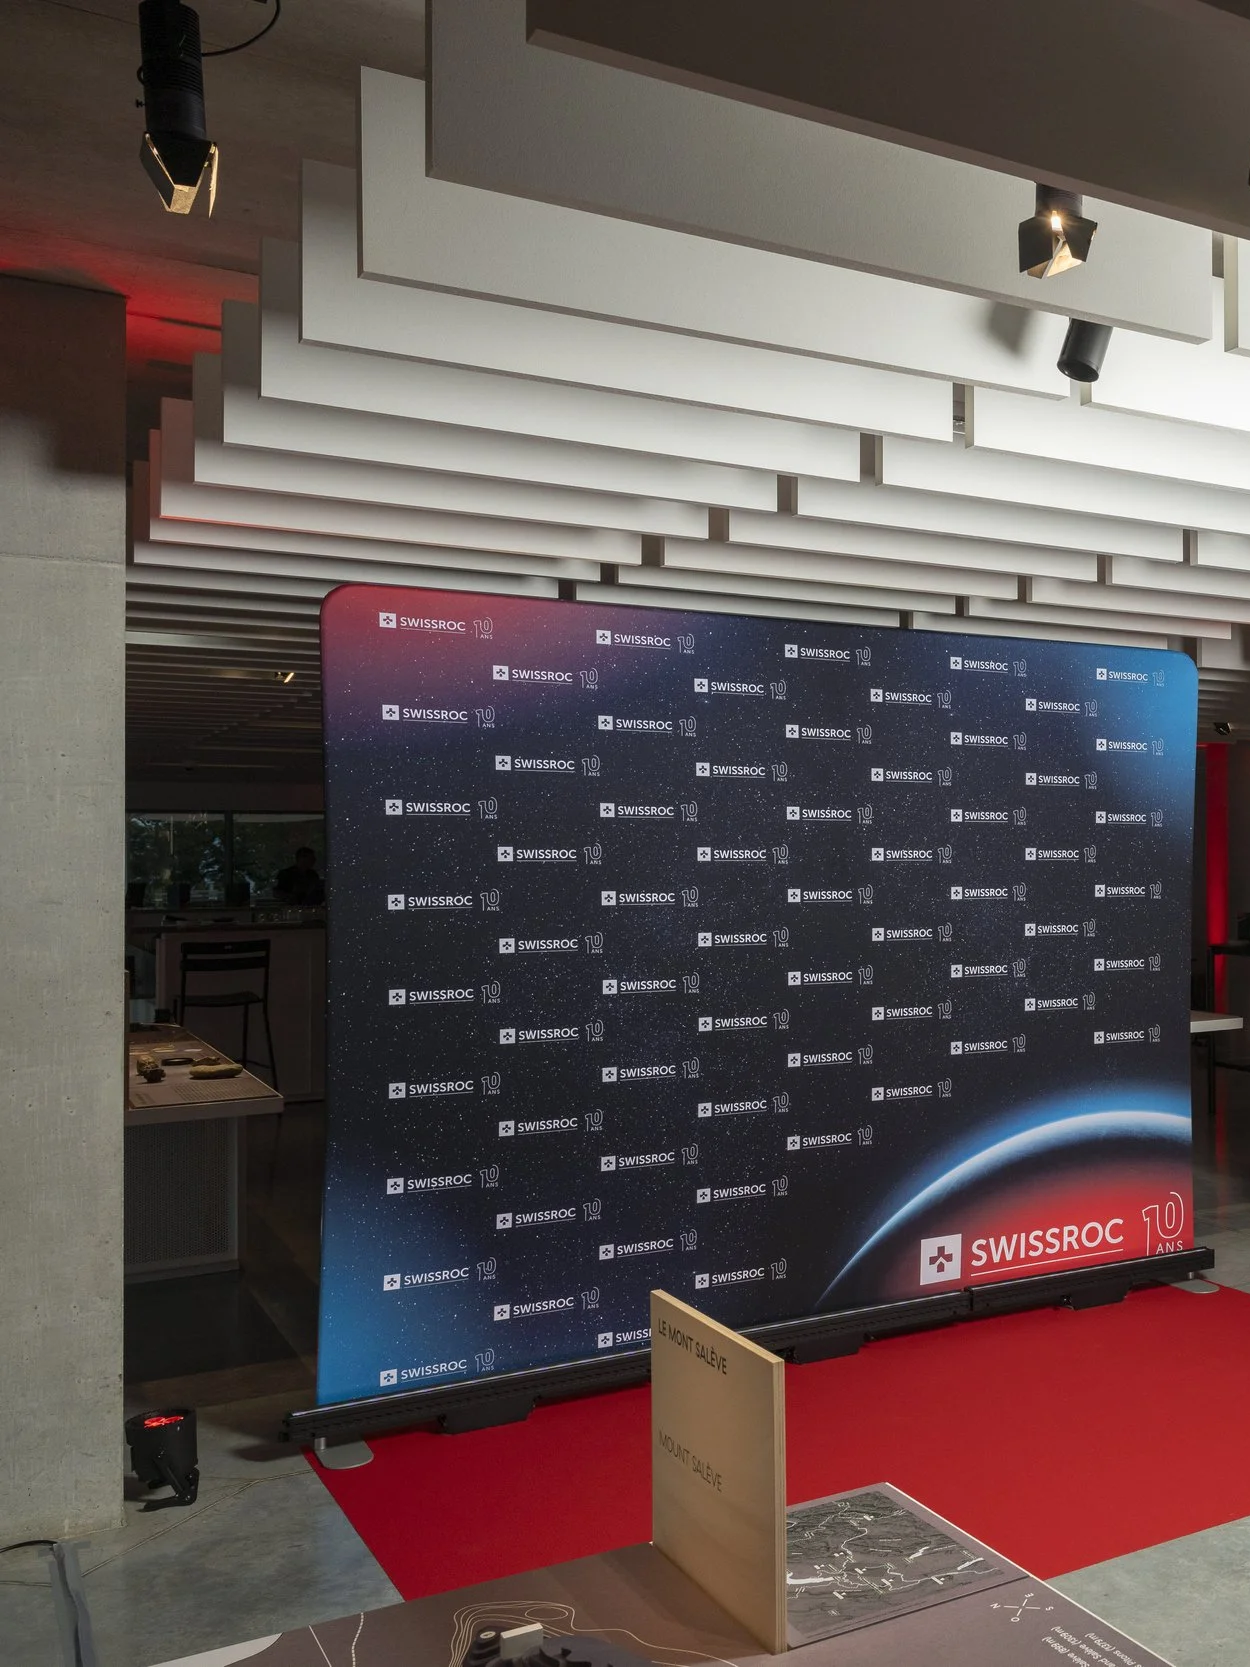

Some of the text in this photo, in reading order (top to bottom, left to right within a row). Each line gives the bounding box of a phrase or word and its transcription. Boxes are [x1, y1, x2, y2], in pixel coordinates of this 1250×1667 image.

[400, 616, 466, 632] SWISSROC
[613, 633, 670, 645] SWISSROC
[800, 647, 850, 658] SWISSROC
[964, 660, 1008, 670] SWISSROC
[511, 669, 572, 682] SWISSROC
[1109, 670, 1149, 680] SWISSROC
[711, 682, 764, 693] SWISSROC
[885, 692, 931, 703] SWISSROC
[1038, 702, 1080, 711] SWISSROC
[403, 709, 468, 721] SWISSROC
[616, 719, 672, 730] SWISSROC
[801, 728, 851, 738] SWISSROC
[964, 735, 1008, 745] SWISSROC
[1108, 742, 1147, 751] SWISSROC
[514, 759, 575, 769] SWISSROC
[712, 765, 765, 775] SWISSROC
[1038, 776, 1079, 784] SWISSROC
[406, 802, 470, 812] SWISSROC
[618, 806, 674, 815] SWISSROC
[802, 809, 852, 818] SWISSROC
[964, 812, 1007, 820] SWISSROC
[516, 849, 577, 858] SWISSROC
[714, 850, 766, 858] SWISSROC
[408, 895, 472, 905] SWISSROC
[619, 892, 675, 902] SWISSROC
[803, 890, 852, 899] SWISSROC
[886, 928, 932, 937] SWISSROC
[1037, 924, 1078, 933] SWISSROC
[518, 938, 578, 949] SWISSROC
[964, 964, 1007, 974] SWISSROC
[1106, 959, 1145, 968] SWISSROC
[803, 971, 852, 981] SWISSROC
[620, 979, 676, 990] SWISSROC
[409, 988, 473, 1000] SWISSROC
[1037, 999, 1078, 1008] SWISSROC
[886, 1007, 932, 1017] SWISSROC
[715, 1016, 767, 1028] SWISSROC
[518, 1028, 578, 1040] SWISSROC
[1106, 1032, 1145, 1041] SWISSROC
[964, 1040, 1007, 1051] SWISSROC
[803, 1052, 852, 1063] SWISSROC
[620, 1065, 676, 1078] SWISSROC
[408, 1081, 473, 1095] SWISSROC
[886, 1085, 932, 1097] SWISSROC
[714, 1100, 766, 1113] SWISSROC
[517, 1118, 577, 1132] SWISSROC
[803, 1133, 852, 1146] SWISSROC
[618, 1152, 675, 1166] SWISSROC
[407, 1174, 472, 1190] SWISSROC
[713, 1184, 766, 1198] SWISSROC
[515, 1207, 576, 1224] SWISSROC
[971, 1192, 1184, 1266] SWISSROC 10
[617, 1238, 673, 1255] SWISSROC
[1156, 1240, 1183, 1254] ANS
[404, 1266, 469, 1285] SWISSROC
[711, 1267, 764, 1284] SWISSROC
[513, 1297, 573, 1315] SWISSROC
[616, 1328, 652, 1342] SWISS
[658, 1318, 727, 1375] LE MONT SALÈVE
[400, 1359, 466, 1380] SWISSROC
[659, 1430, 722, 1493] MOUNT SALÈVE
